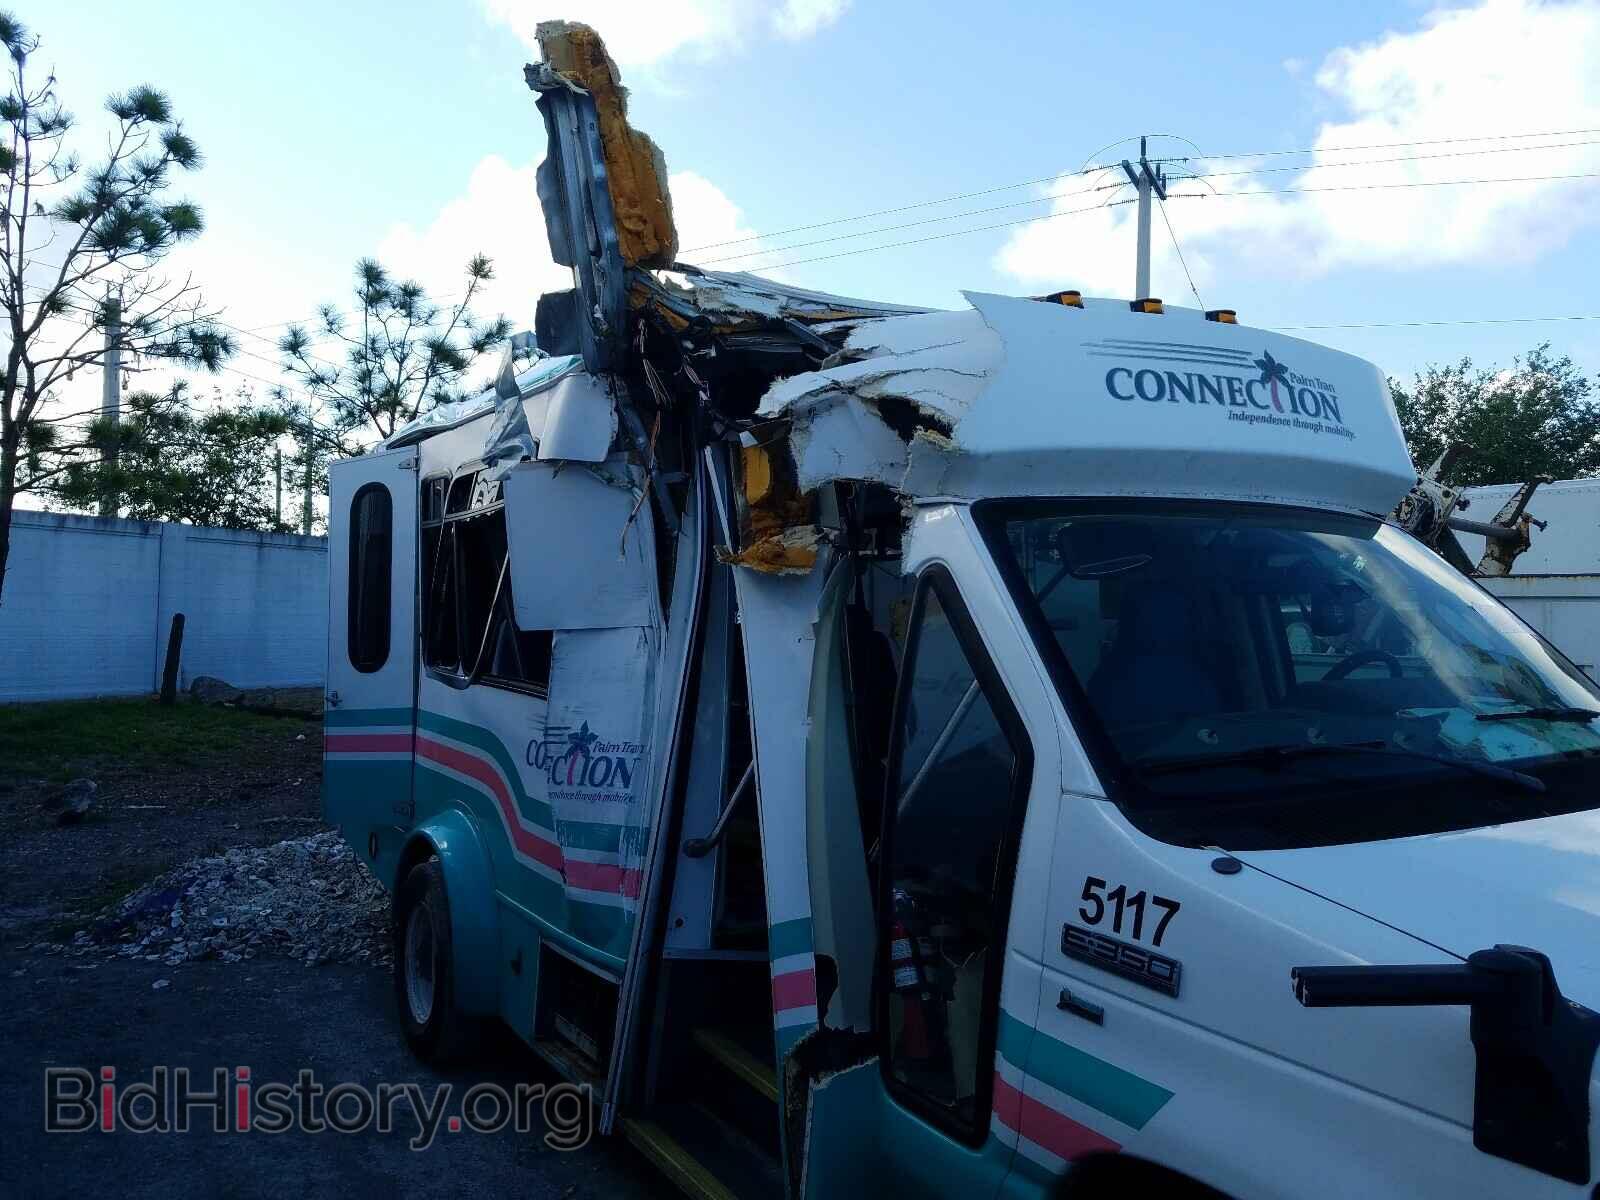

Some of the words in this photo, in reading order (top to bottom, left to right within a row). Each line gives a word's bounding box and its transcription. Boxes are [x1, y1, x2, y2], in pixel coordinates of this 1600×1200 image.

[1290, 373, 1316, 388] Palm
[1315, 377, 1336, 393] Tran
[1105, 367, 1343, 425] CONNECTION
[1228, 410, 1291, 426] Independence
[1292, 417, 1324, 433] through
[592, 740, 621, 753] Palm
[1079, 876, 1181, 947] 5117
